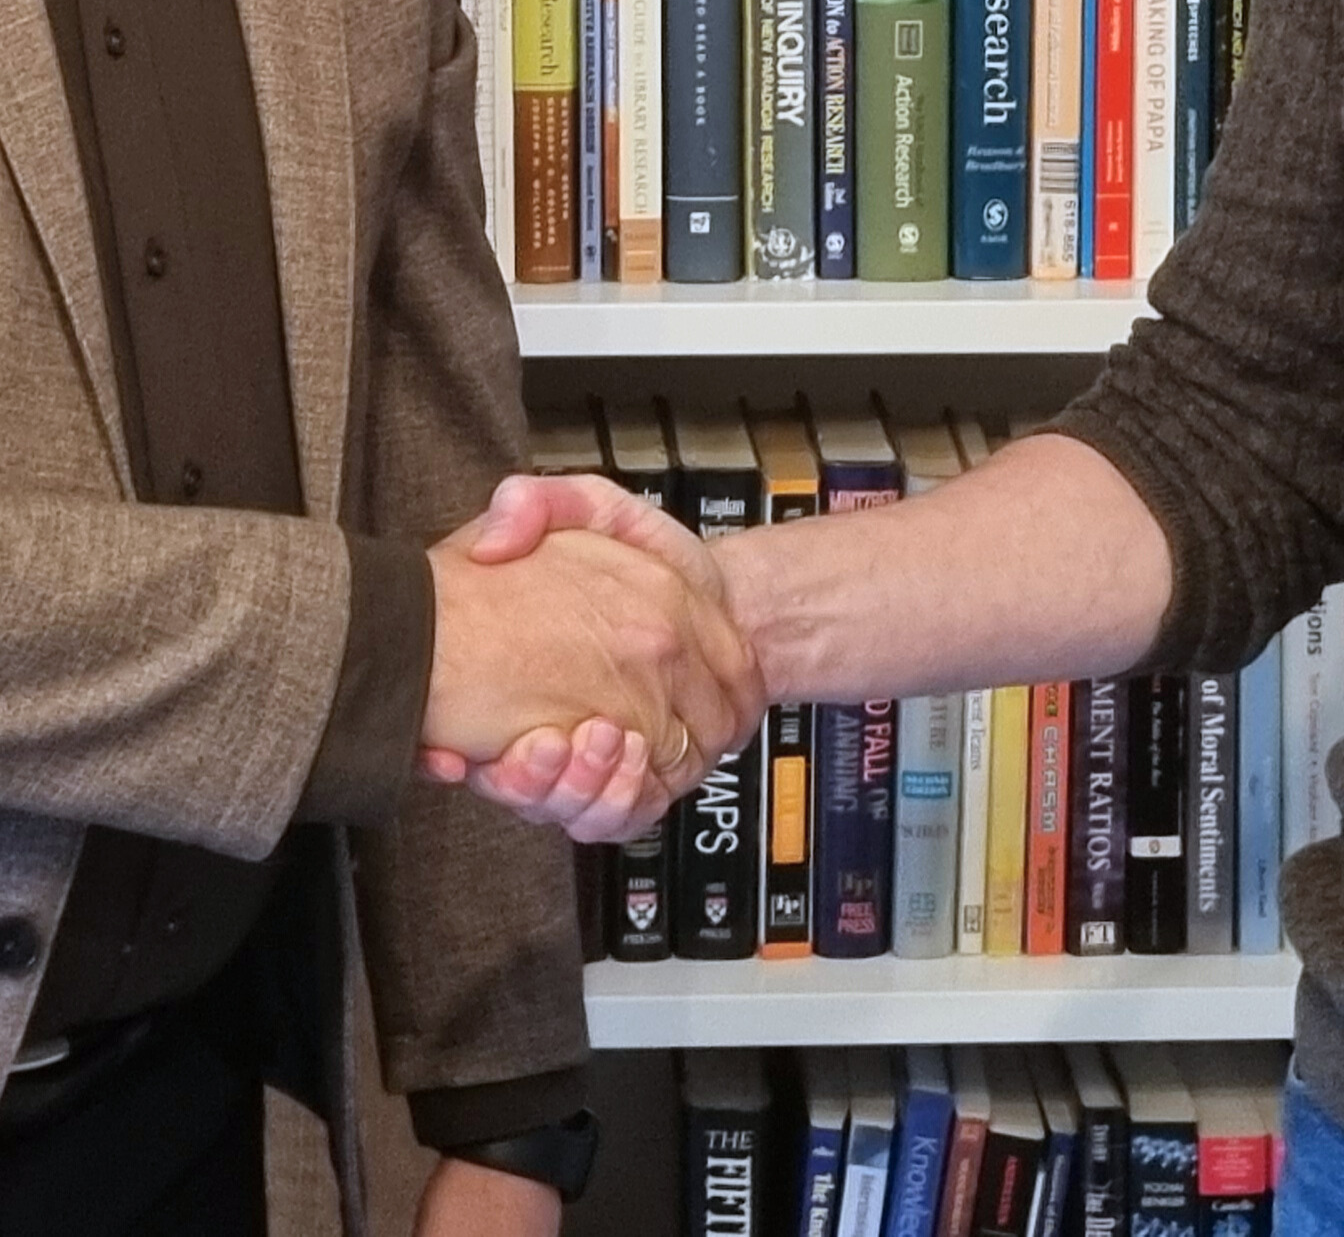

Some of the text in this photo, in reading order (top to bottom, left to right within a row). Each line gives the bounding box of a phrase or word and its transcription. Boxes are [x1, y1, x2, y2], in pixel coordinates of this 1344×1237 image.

[777, 0, 805, 125] INQUIRY
[825, 36, 845, 91] ACTION
[1148, 63, 1166, 91] OF
[825, 95, 845, 174] RESEARCH
[895, 75, 914, 207] Action Research
[1148, 99, 1165, 152] PAPA
[863, 723, 891, 781] FALL
[1086, 679, 1114, 871] MENT RATIOS
[1198, 679, 1226, 912] of Moral Sentiments
[838, 919, 875, 934] PRESS
[704, 1130, 756, 1150] THE
